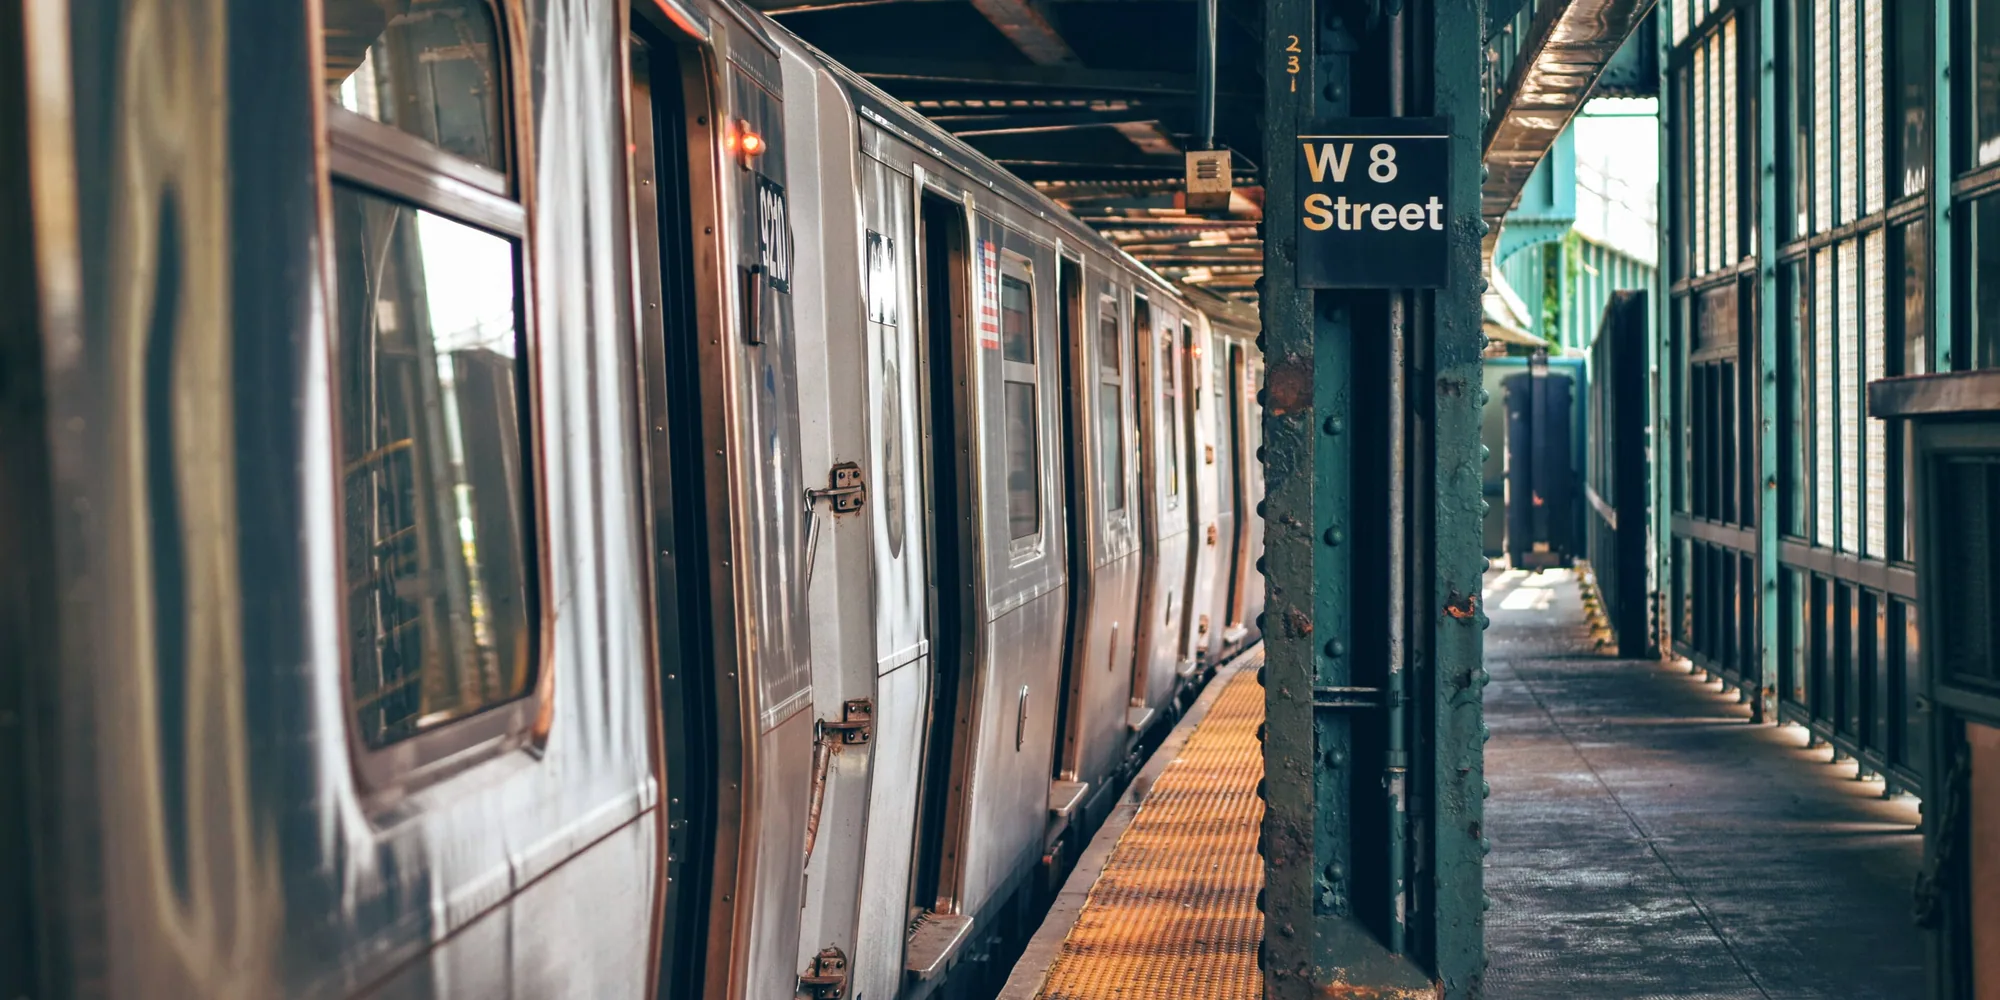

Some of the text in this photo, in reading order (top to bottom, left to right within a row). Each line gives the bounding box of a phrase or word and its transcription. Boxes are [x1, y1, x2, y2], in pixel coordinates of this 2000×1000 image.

[1286, 35, 1302, 92] 231
[1303, 143, 1398, 184] W 8
[760, 186, 786, 282] 9210
[1303, 193, 1444, 231] Street
